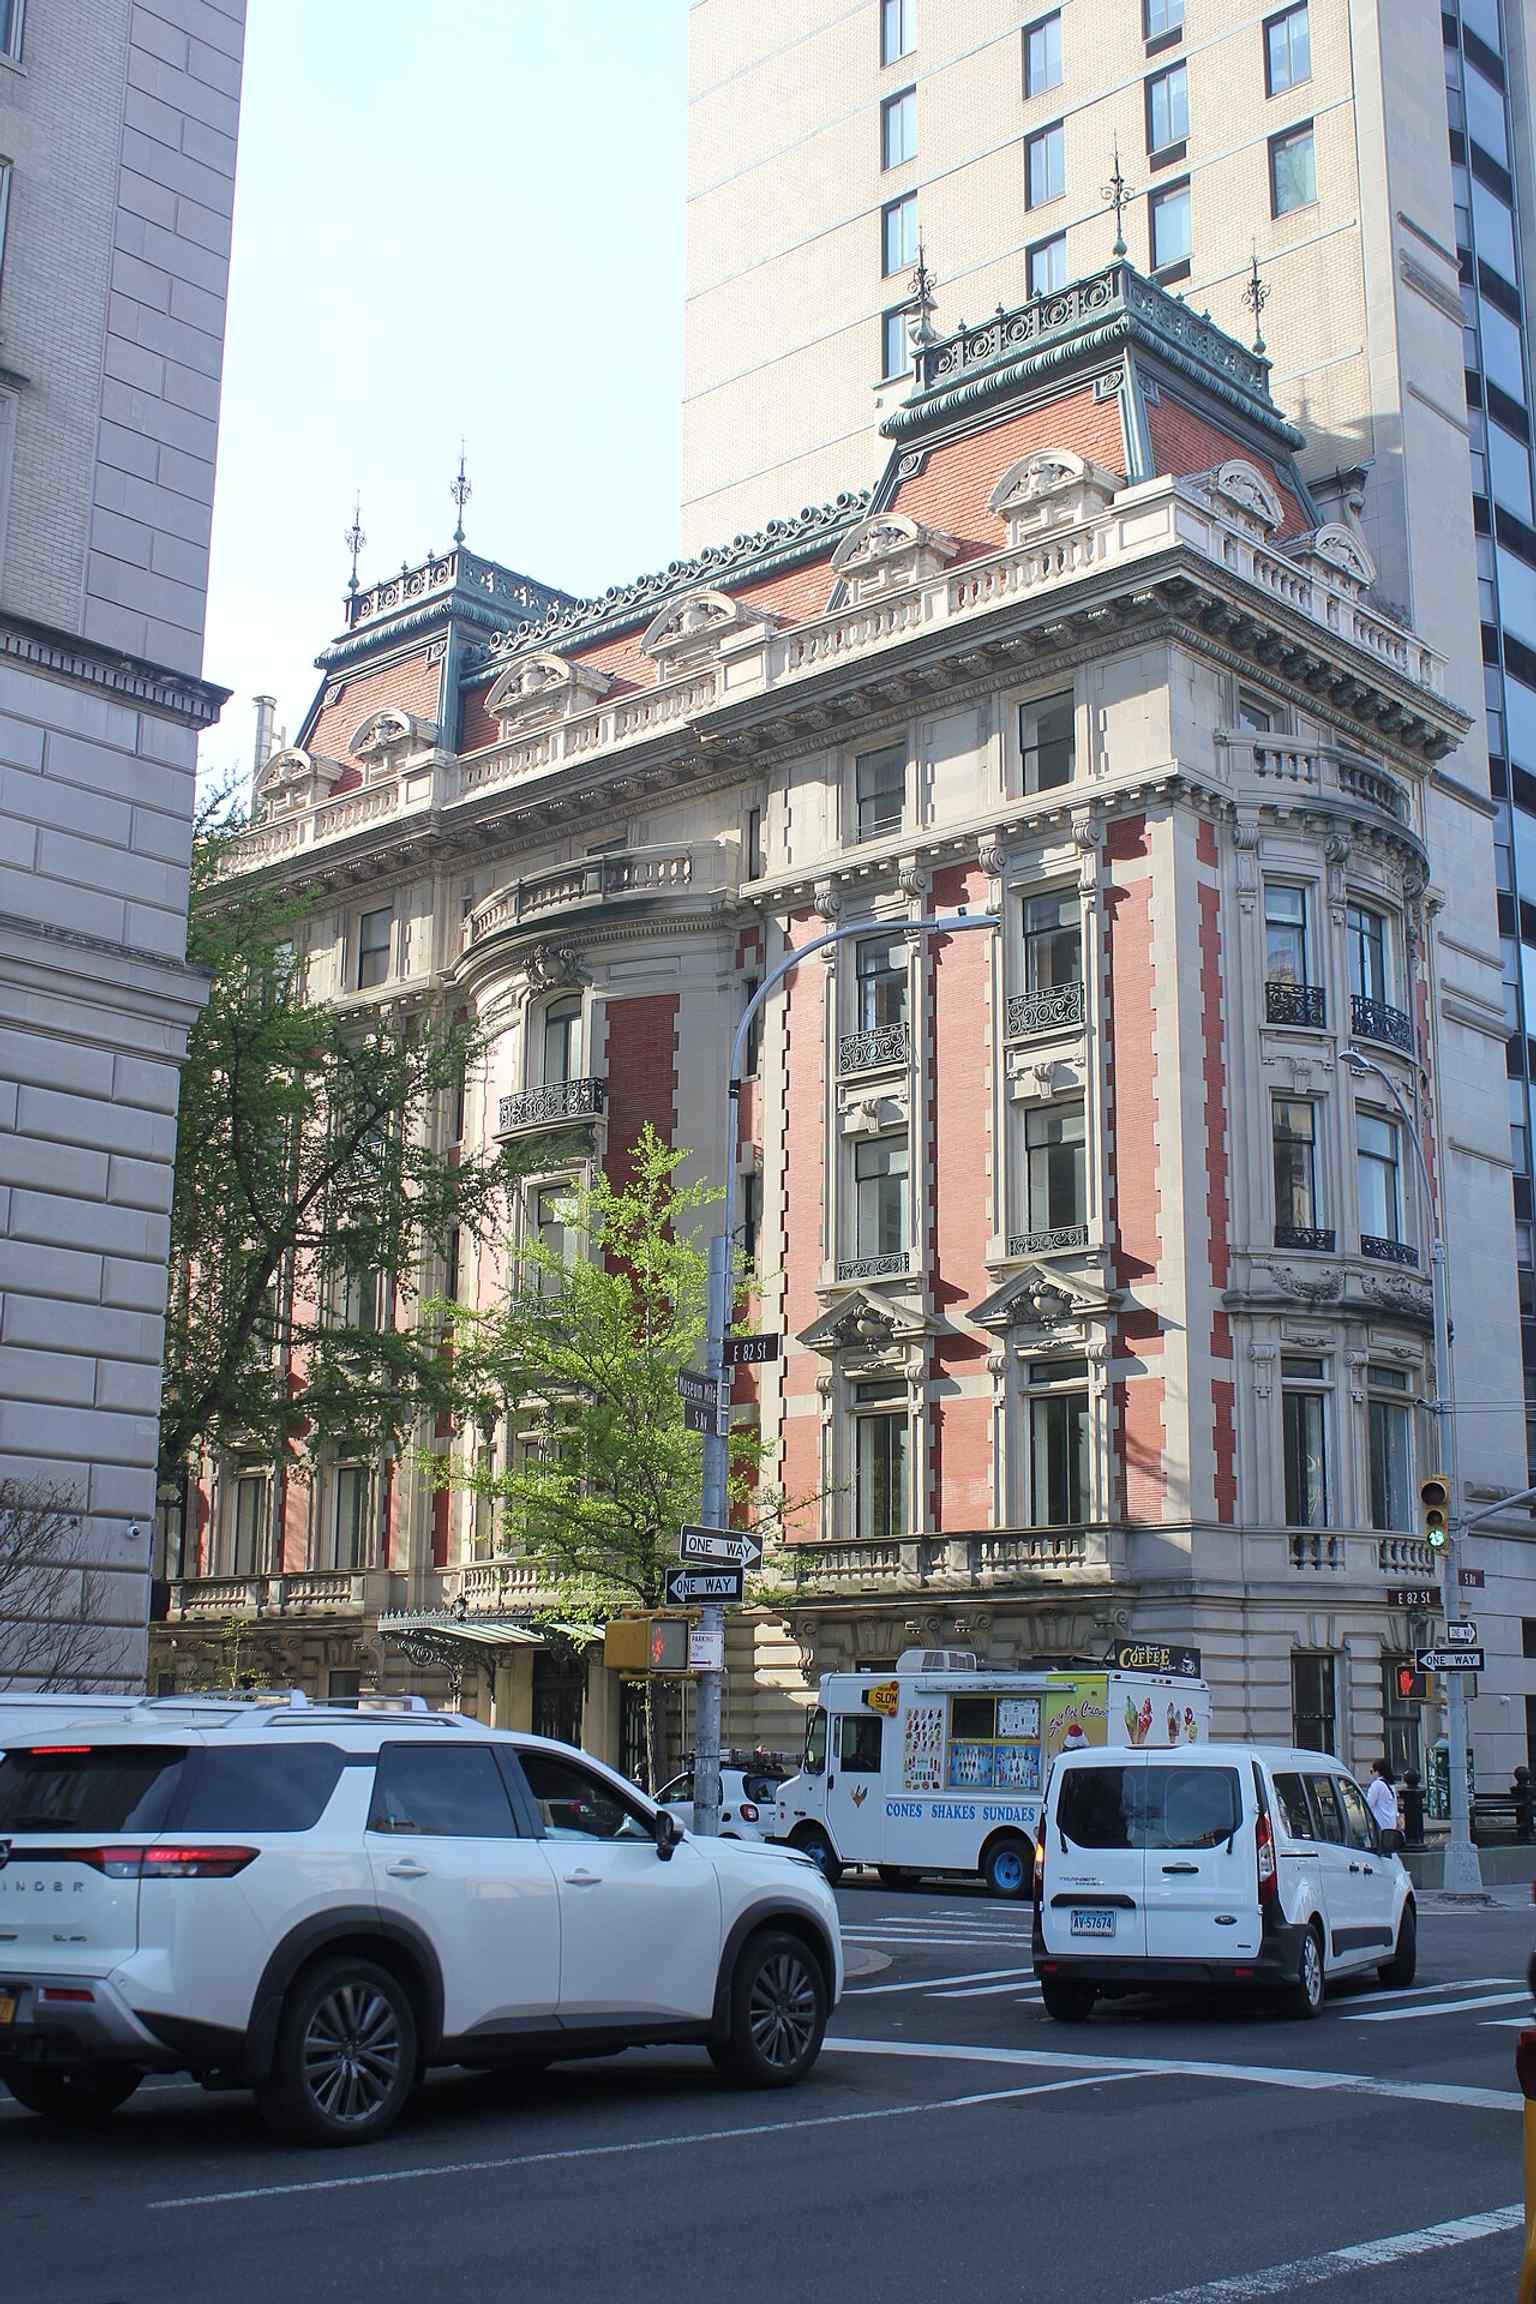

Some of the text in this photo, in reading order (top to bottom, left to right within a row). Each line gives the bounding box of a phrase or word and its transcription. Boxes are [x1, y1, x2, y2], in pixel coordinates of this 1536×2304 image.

[733, 1341, 767, 1361] E 82 St
[688, 1536, 752, 1559] ONE WAY
[676, 1578, 731, 1593] ONE WAY
[1398, 1591, 1431, 1604] E 82 St
[1119, 1647, 1170, 1669] COFFEE
[1426, 1655, 1475, 1665] ONE WAY
[875, 1692, 897, 1705] SLOW
[886, 1803, 1036, 1821] CONES SHAKES SUNDAES
